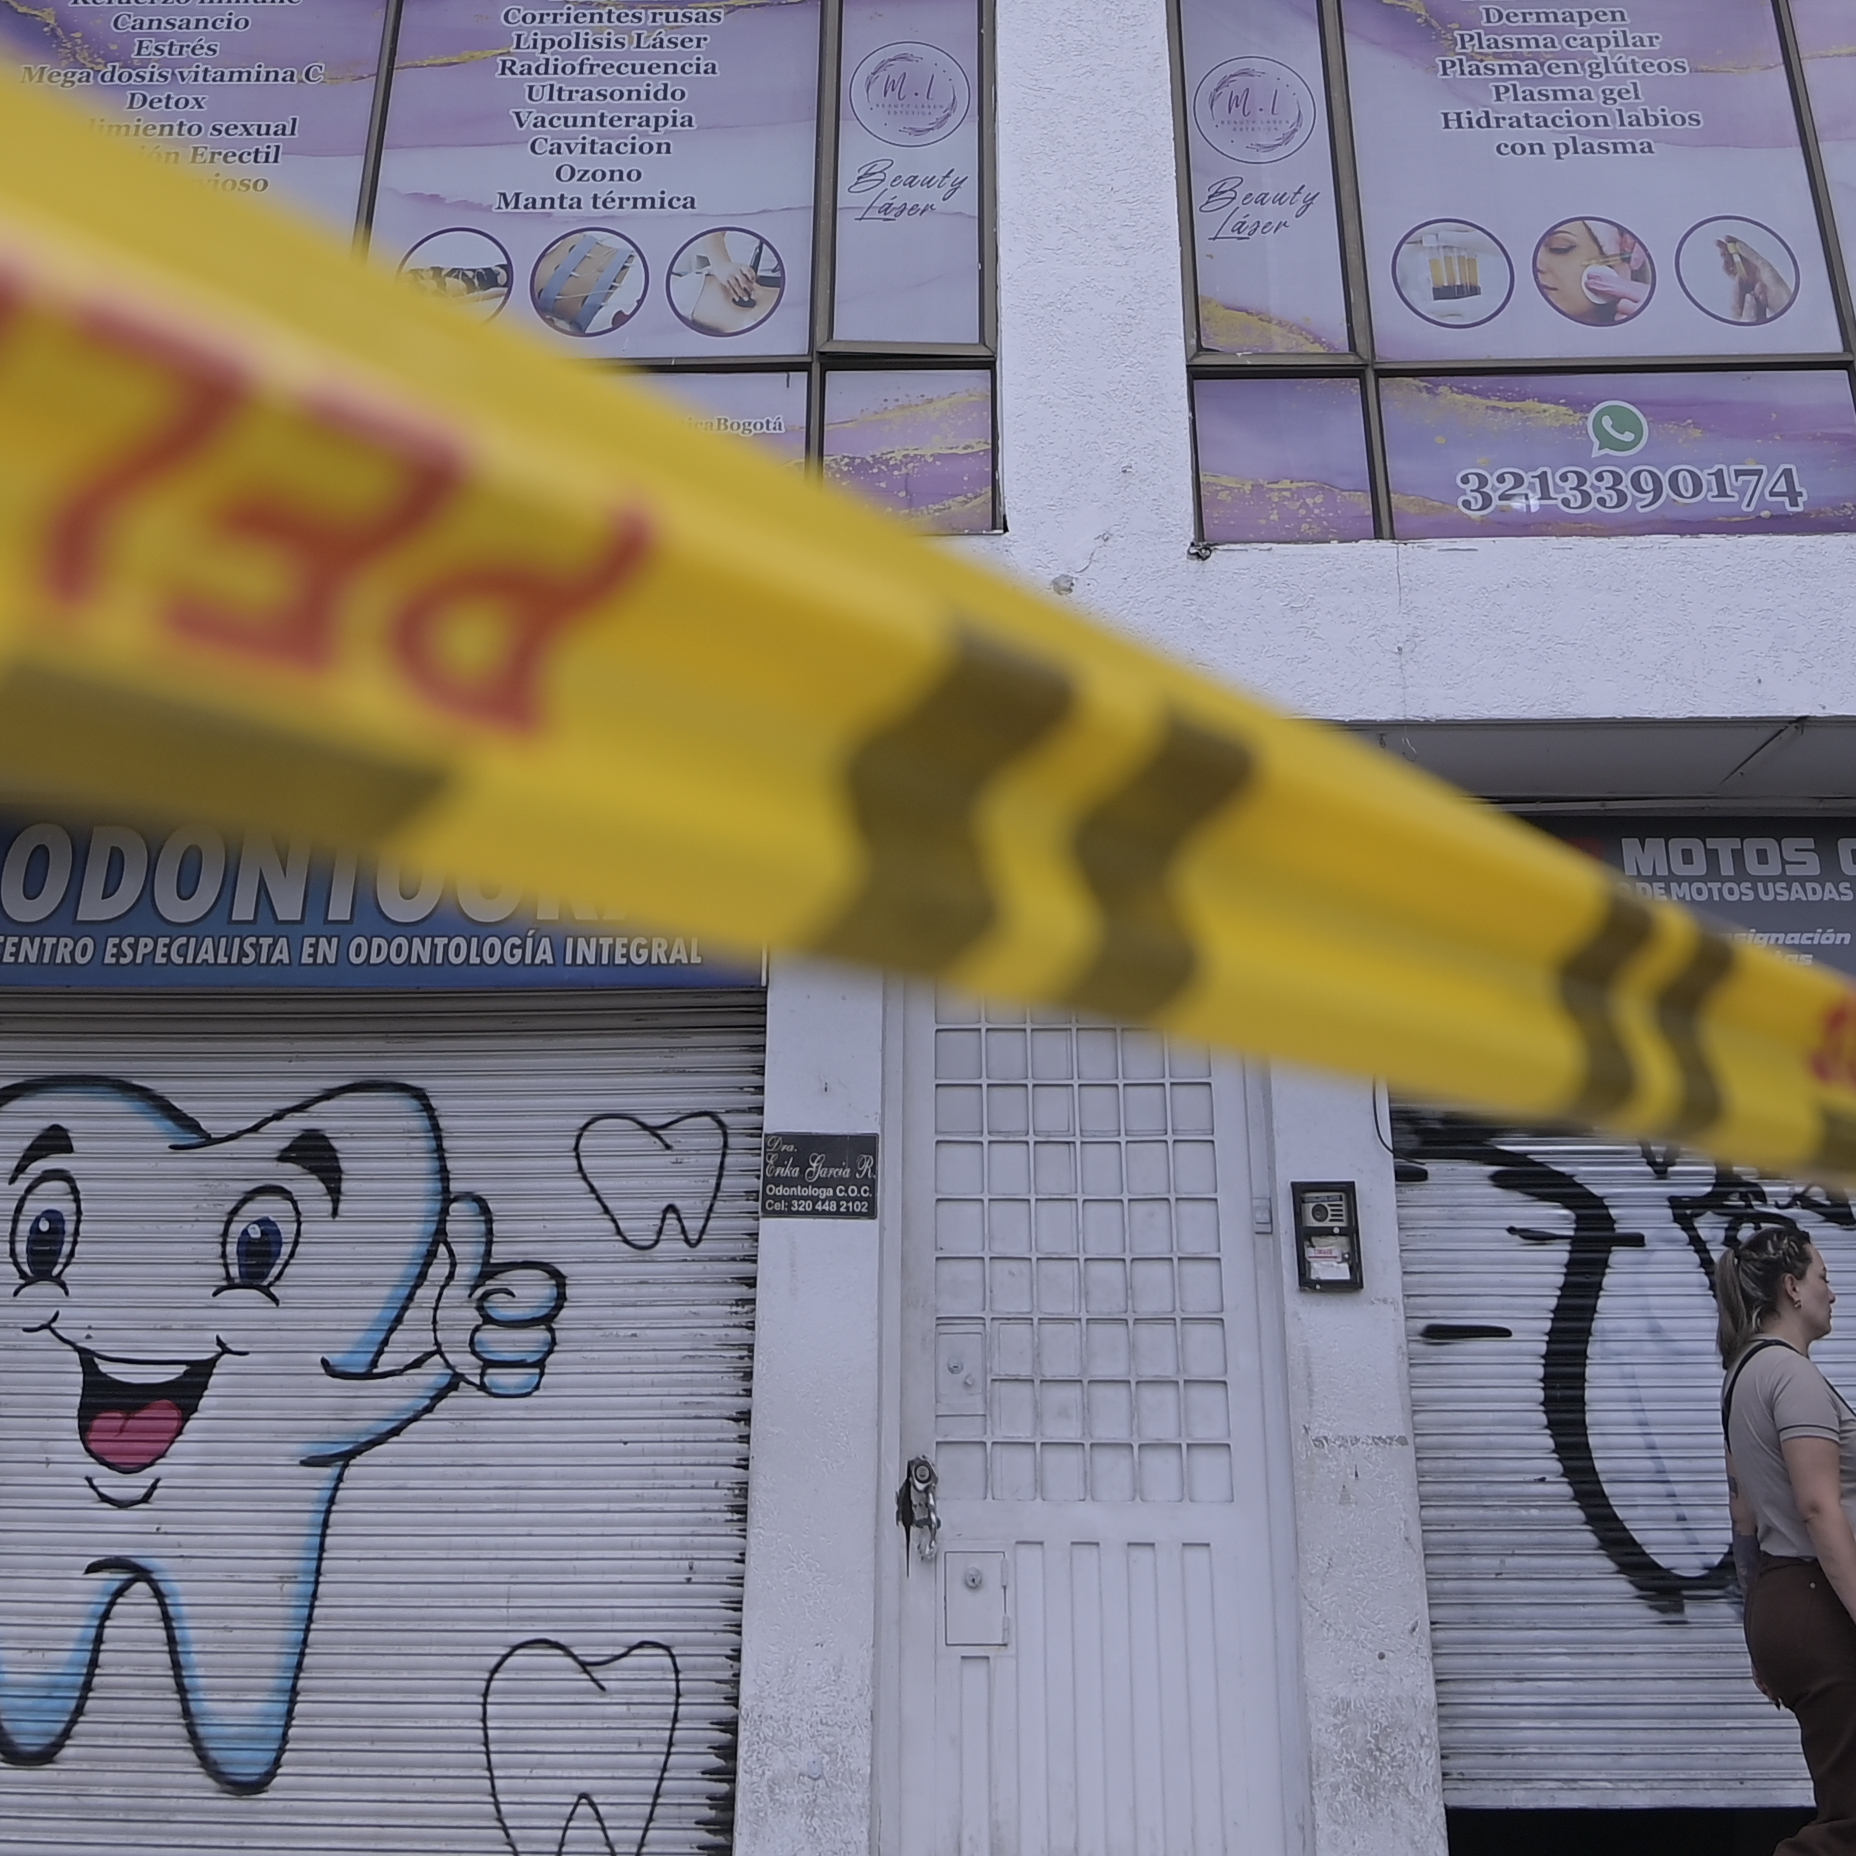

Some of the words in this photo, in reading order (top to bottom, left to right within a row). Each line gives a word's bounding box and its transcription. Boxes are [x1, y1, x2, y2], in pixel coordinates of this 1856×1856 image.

[112, 12, 251, 32] Cansancio
[501, 6, 643, 26] Corrientes
[647, 9, 724, 25] rusas
[1482, 6, 1629, 28] Dermapen
[133, 37, 220, 58] Estrés
[512, 32, 629, 55] Lipolisis
[632, 30, 710, 51] Láser
[1456, 31, 1560, 52] Plasma
[1564, 29, 1661, 55] capilar
[19, 65, 92, 89] Mega
[100, 64, 170, 85] dosis
[178, 63, 297, 84] vitamina
[304, 63, 326, 84] C
[498, 57, 718, 78] Radiofrecuencia
[1438, 58, 1540, 78] Plasma
[1546, 62, 1586, 78] en
[1589, 55, 1688, 81] glúteos
[125, 91, 209, 111] Detox
[526, 83, 687, 104] Ultrasonido
[1492, 84, 1595, 104] Plasma
[1601, 82, 1642, 106] gel
[209, 116, 298, 137] sexual
[513, 109, 695, 134] Vacunterapia
[1442, 109, 1613, 130] Hidratacion
[1618, 108, 1702, 128] labios
[188, 144, 282, 165] Erectil
[529, 136, 673, 157] Cavitacion
[1496, 140, 1548, 157] con
[1554, 135, 1655, 161] plasma
[554, 164, 643, 183] Ozono
[847, 158, 969, 202] Beauty
[494, 191, 584, 211] Manta
[590, 189, 698, 211] térmica
[854, 188, 937, 222] Láser
[1199, 175, 1321, 218] Beauty
[1207, 206, 1290, 241] Láser
[1458, 464, 1803, 513] 3213390174
[1621, 837, 1822, 877] MOTOS
[1634, 881, 1669, 901] DE
[1669, 881, 1755, 901] MOTOS
[1756, 881, 1855, 901] USADAS
[102, 933, 291, 968] ESPECIALISTA
[300, 934, 340, 967] EN
[346, 926, 555, 967] ODONTOLOGÍA
[562, 933, 703, 968] INTEGRAL
[766, 1135, 798, 1153] Dra.
[765, 1152, 801, 1178] Erika
[855, 1153, 877, 1179] R.
[766, 1184, 834, 1199] Odontologa
[835, 1185, 873, 1198] C.O.C.
[790, 1199, 813, 1212] 320
[814, 1200, 837, 1212] 448
[839, 1200, 869, 1213] 2102
